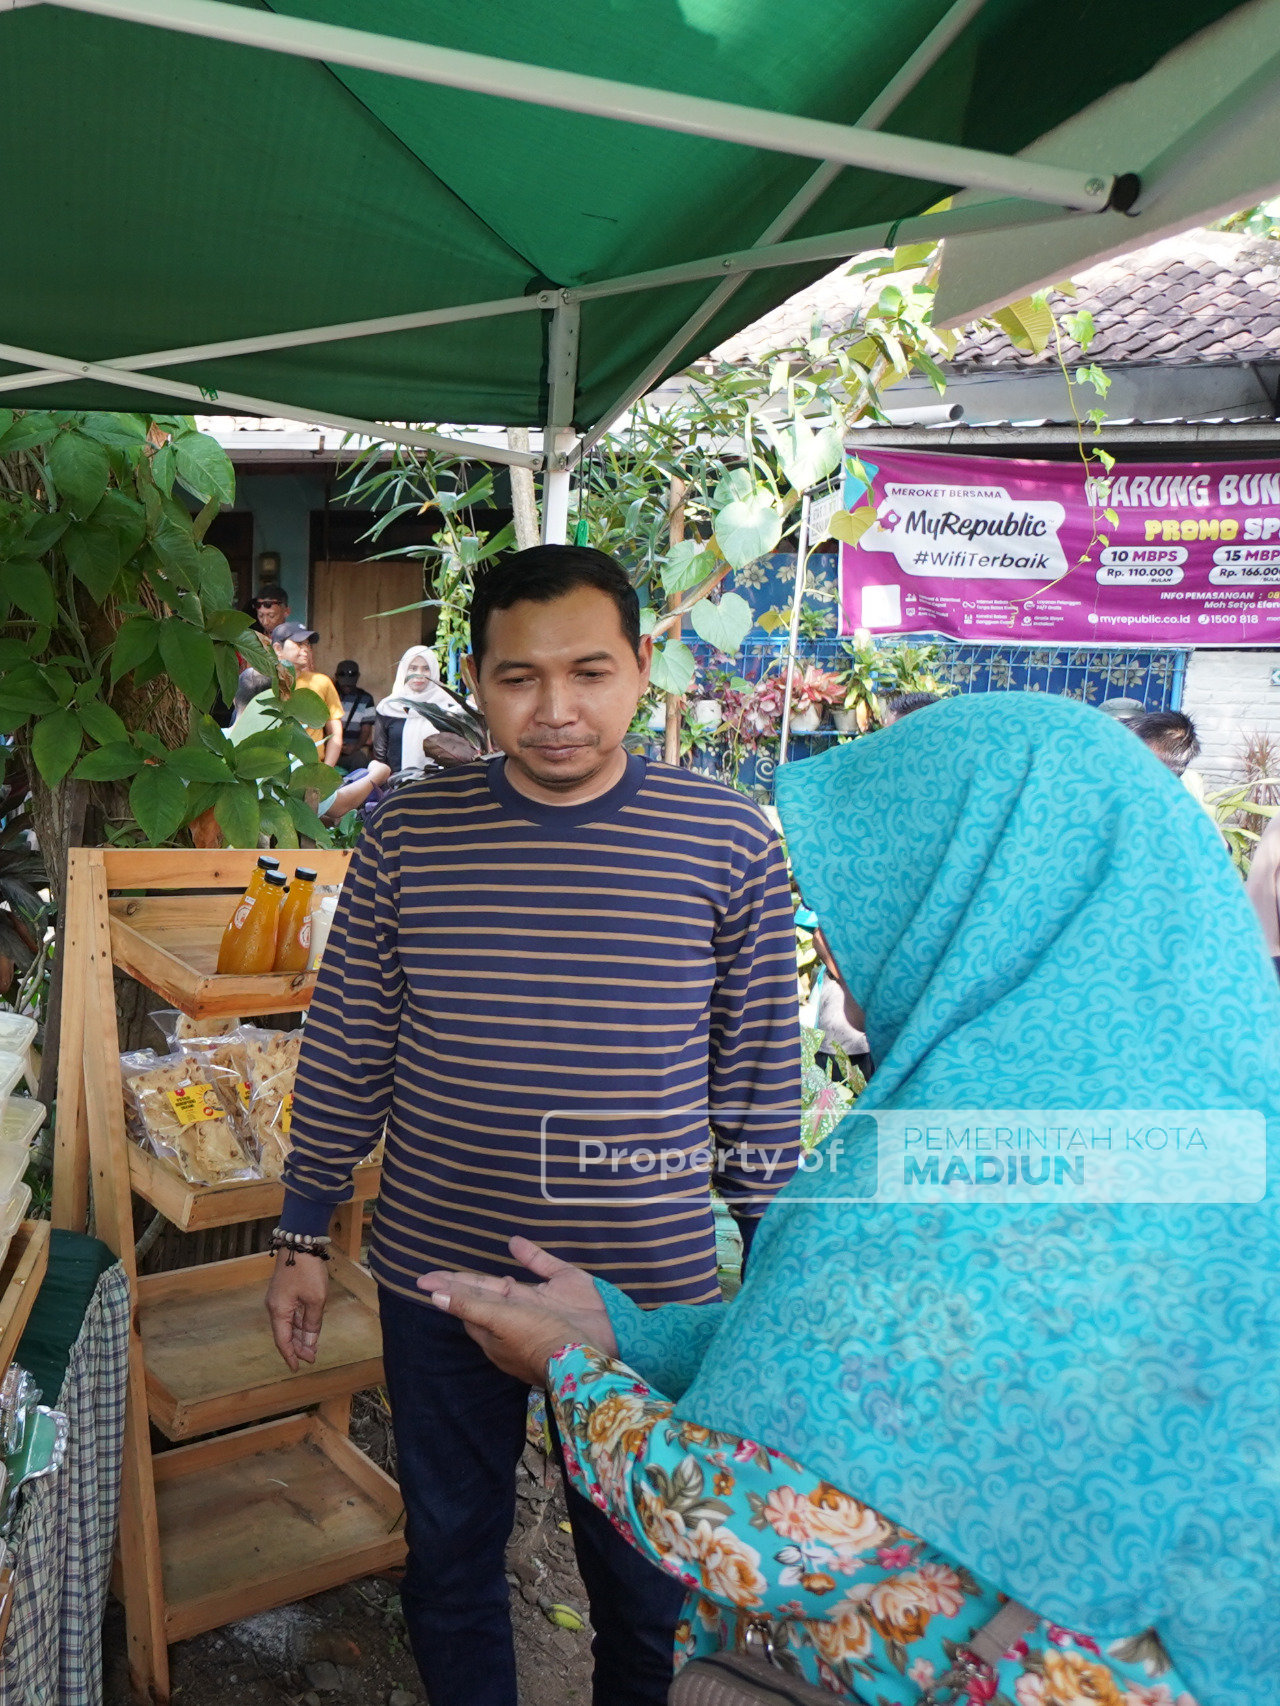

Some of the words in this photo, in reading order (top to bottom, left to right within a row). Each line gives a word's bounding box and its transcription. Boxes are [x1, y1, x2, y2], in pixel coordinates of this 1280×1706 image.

[891, 487, 946, 498] MEROKET
[949, 489, 1002, 499] BERSAMA
[905, 509, 1047, 541] MyRepublic
[1144, 518, 1239, 541] PROMO
[1243, 517, 1280, 541] SP
[913, 550, 1050, 569] #WifiTerbaik
[1111, 550, 1129, 562] 10
[1132, 550, 1178, 562] MBPS
[1224, 550, 1242, 562] 15
[1107, 568, 1125, 578] Rp.
[1128, 568, 1174, 577] 110.000
[1219, 568, 1238, 578] Rp.
[1241, 567, 1280, 577] 166.00
[1160, 591, 1184, 600] INFO
[1184, 591, 1255, 600] PEMASANGAN
[1204, 601, 1226, 609] Moh
[1100, 614, 1191, 626] myrepublic.co.id
[1210, 614, 1237, 624] 1500
[1239, 614, 1259, 624] 818
